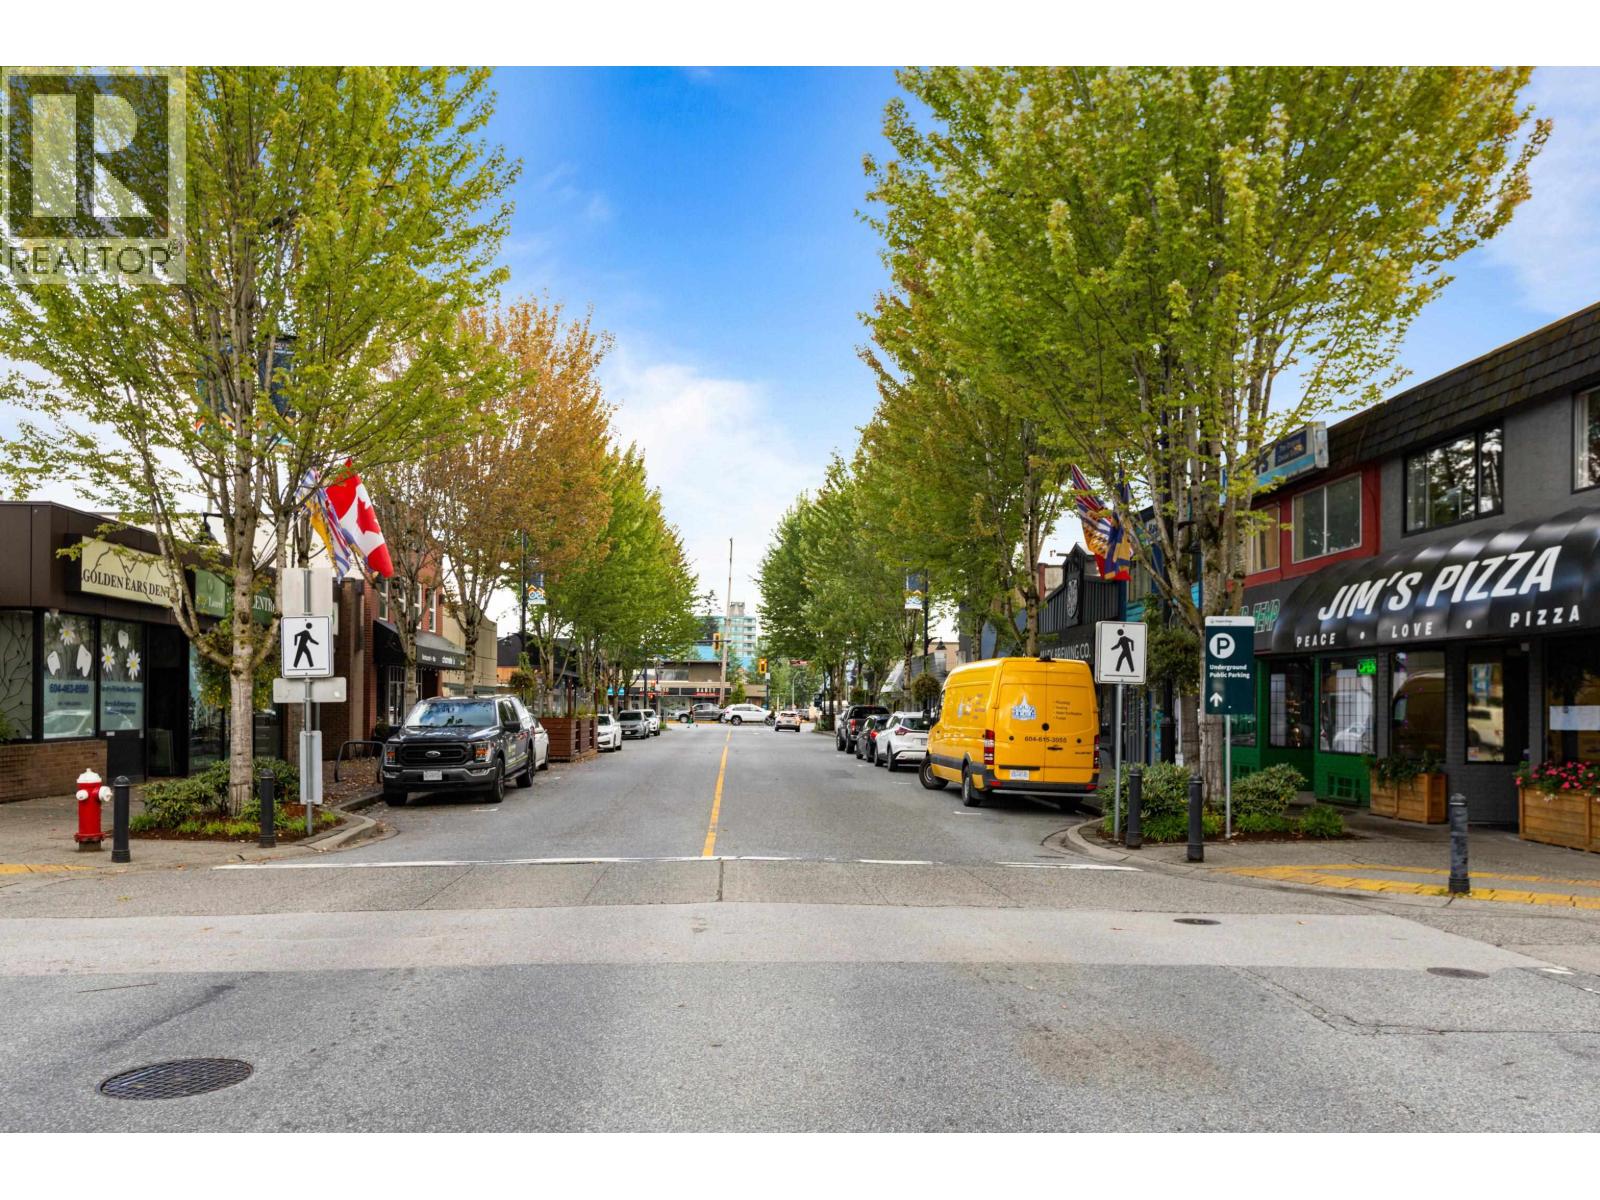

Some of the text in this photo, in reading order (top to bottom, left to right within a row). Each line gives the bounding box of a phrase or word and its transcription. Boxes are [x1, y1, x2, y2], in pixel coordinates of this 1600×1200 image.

[82, 568, 124, 588] GOLDEN
[125, 578, 148, 594] EARS
[1317, 546, 1562, 620] JIM'S PIZZA
[253, 595, 275, 612] ENTR
[1296, 604, 1580, 648] PEACE LOVE PIZZA
[1228, 672, 1251, 680] Parking
